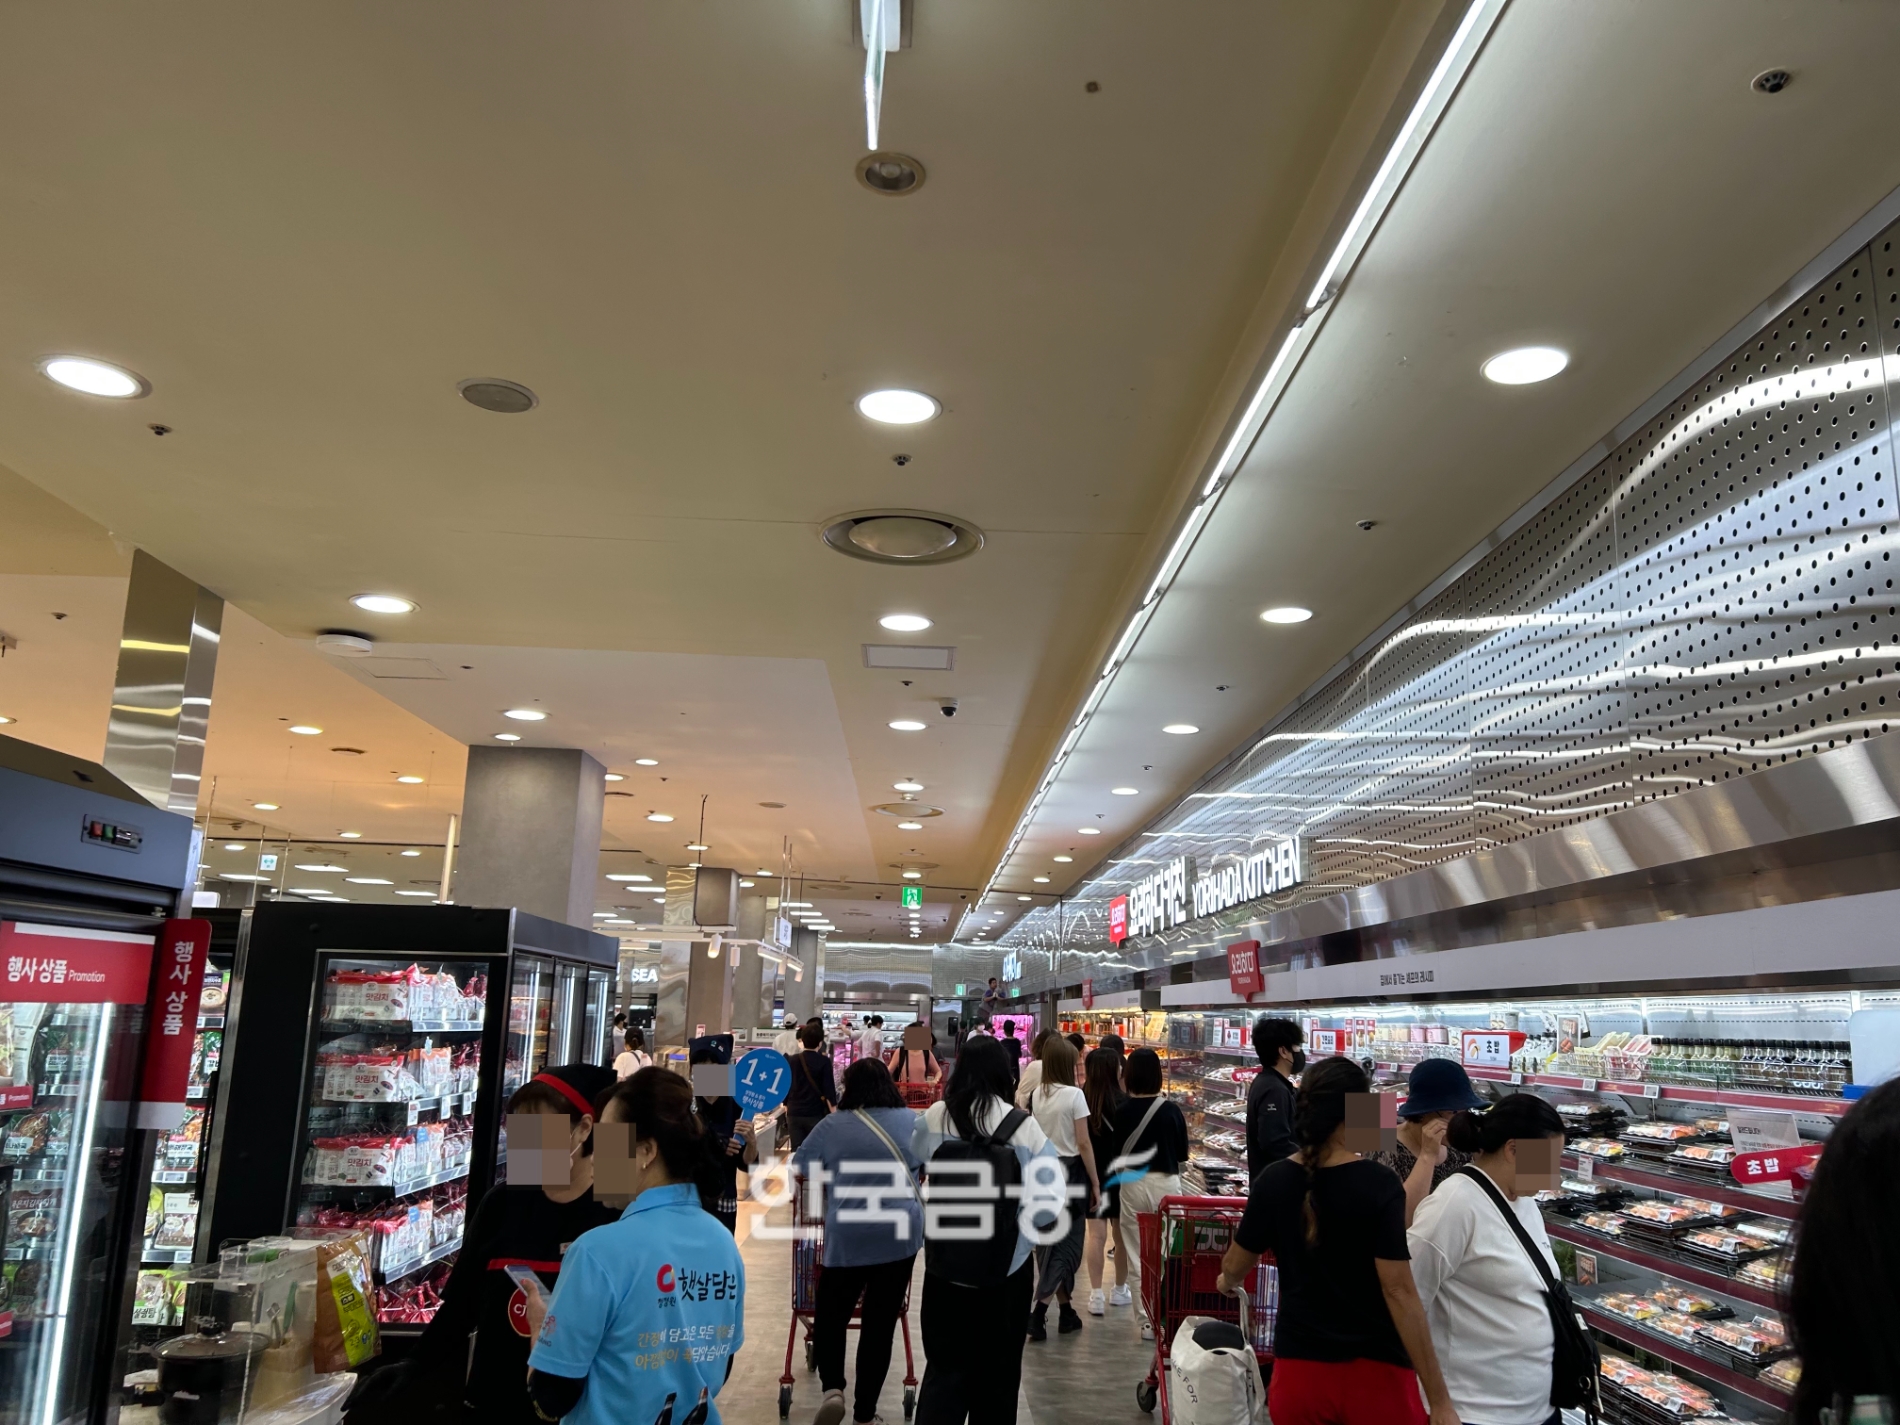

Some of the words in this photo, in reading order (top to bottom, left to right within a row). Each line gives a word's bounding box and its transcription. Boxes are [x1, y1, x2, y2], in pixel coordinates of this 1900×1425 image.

[1192, 864, 1242, 919] YORIHADA
[1242, 836, 1301, 903] KITCHEN
[8, 956, 37, 983] 행사
[39, 959, 68, 984] 상품
[68, 969, 106, 983] Promotion
[170, 941, 195, 985] 행사
[631, 968, 658, 983] SEA
[1231, 950, 1254, 975] 요리하다
[162, 991, 189, 1036] 상품
[355, 1074, 379, 1084] 맛김치
[741, 1058, 784, 1096] 1+1
[347, 1157, 372, 1168] 맛김치
[1746, 1157, 1780, 1175] 초밥
[678, 1267, 737, 1302] 햇살담은
[513, 1303, 527, 1317] CJ
[697, 1324, 715, 1340] 모든
[1183, 1377, 1198, 1404] FOR
